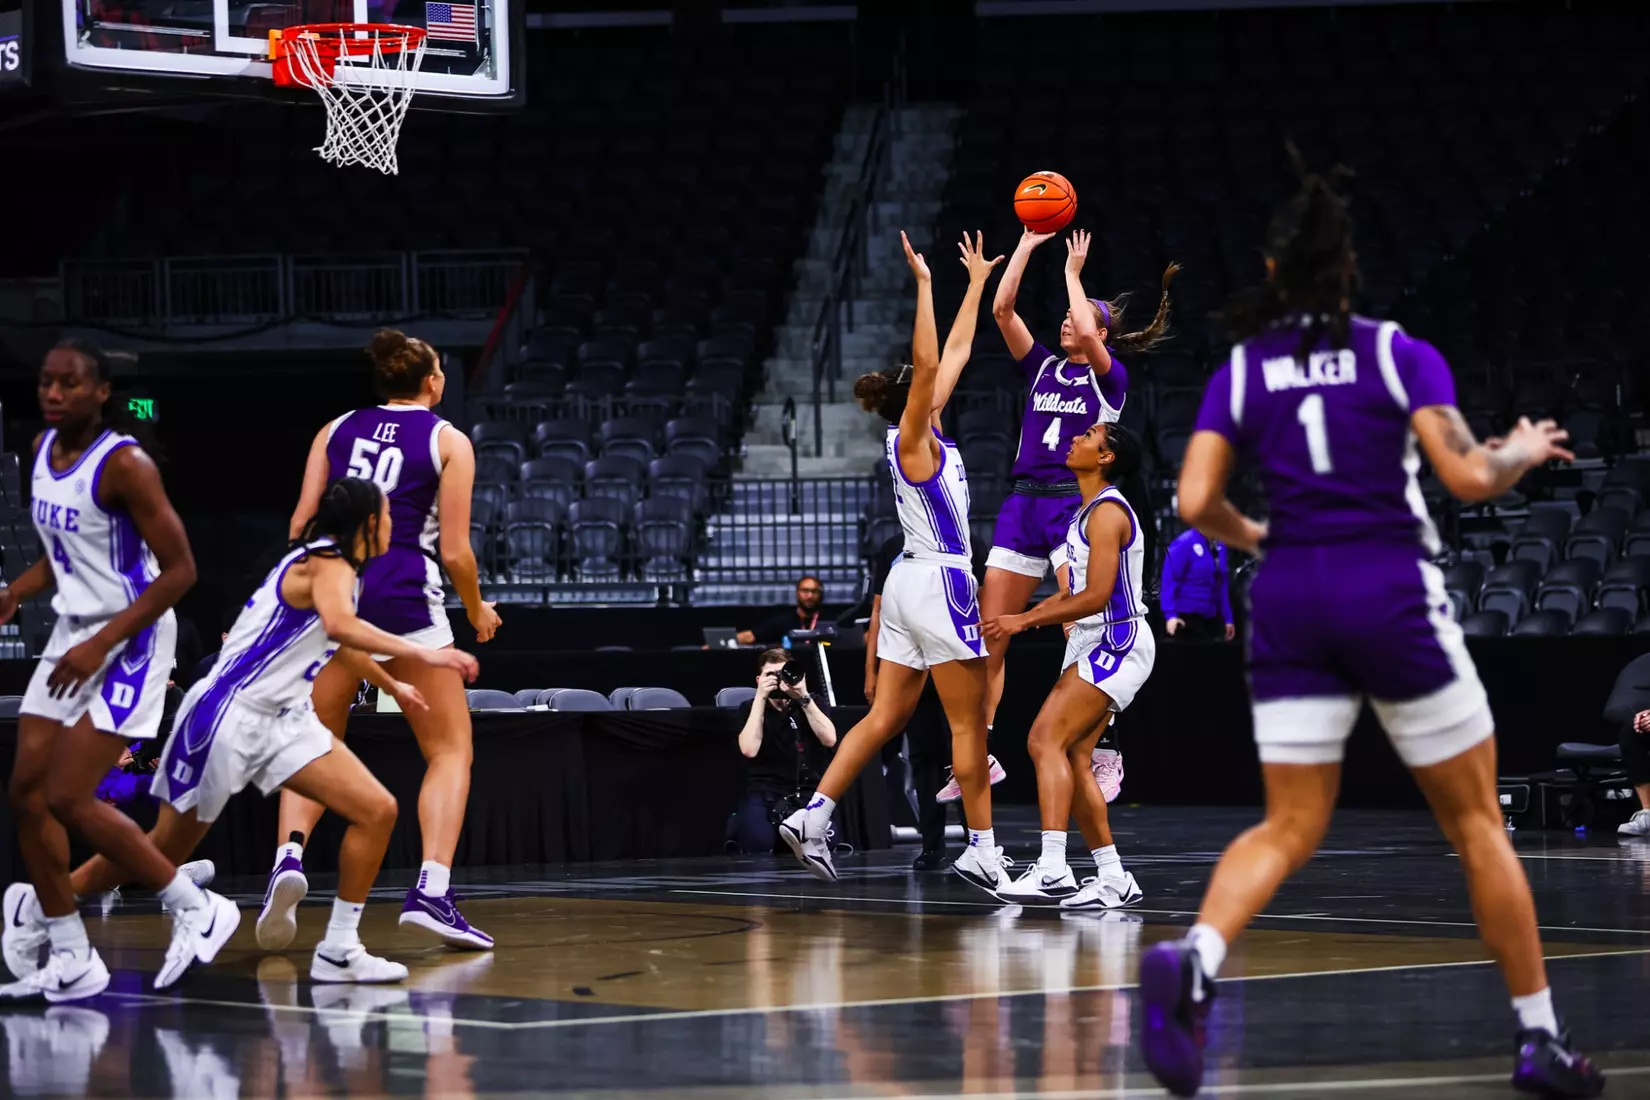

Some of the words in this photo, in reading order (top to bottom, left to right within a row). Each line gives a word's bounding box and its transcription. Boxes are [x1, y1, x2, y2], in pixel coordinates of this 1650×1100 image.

[1261, 348, 1357, 393] WALKER
[1033, 391, 1088, 415] Wildcats
[372, 422, 400, 443] LEE
[1042, 416, 1062, 452] 4
[1296, 393, 1334, 475] 1
[346, 436, 405, 495] 50
[52, 534, 74, 575] 4
[1094, 649, 1116, 671] D
[109, 681, 136, 709] D
